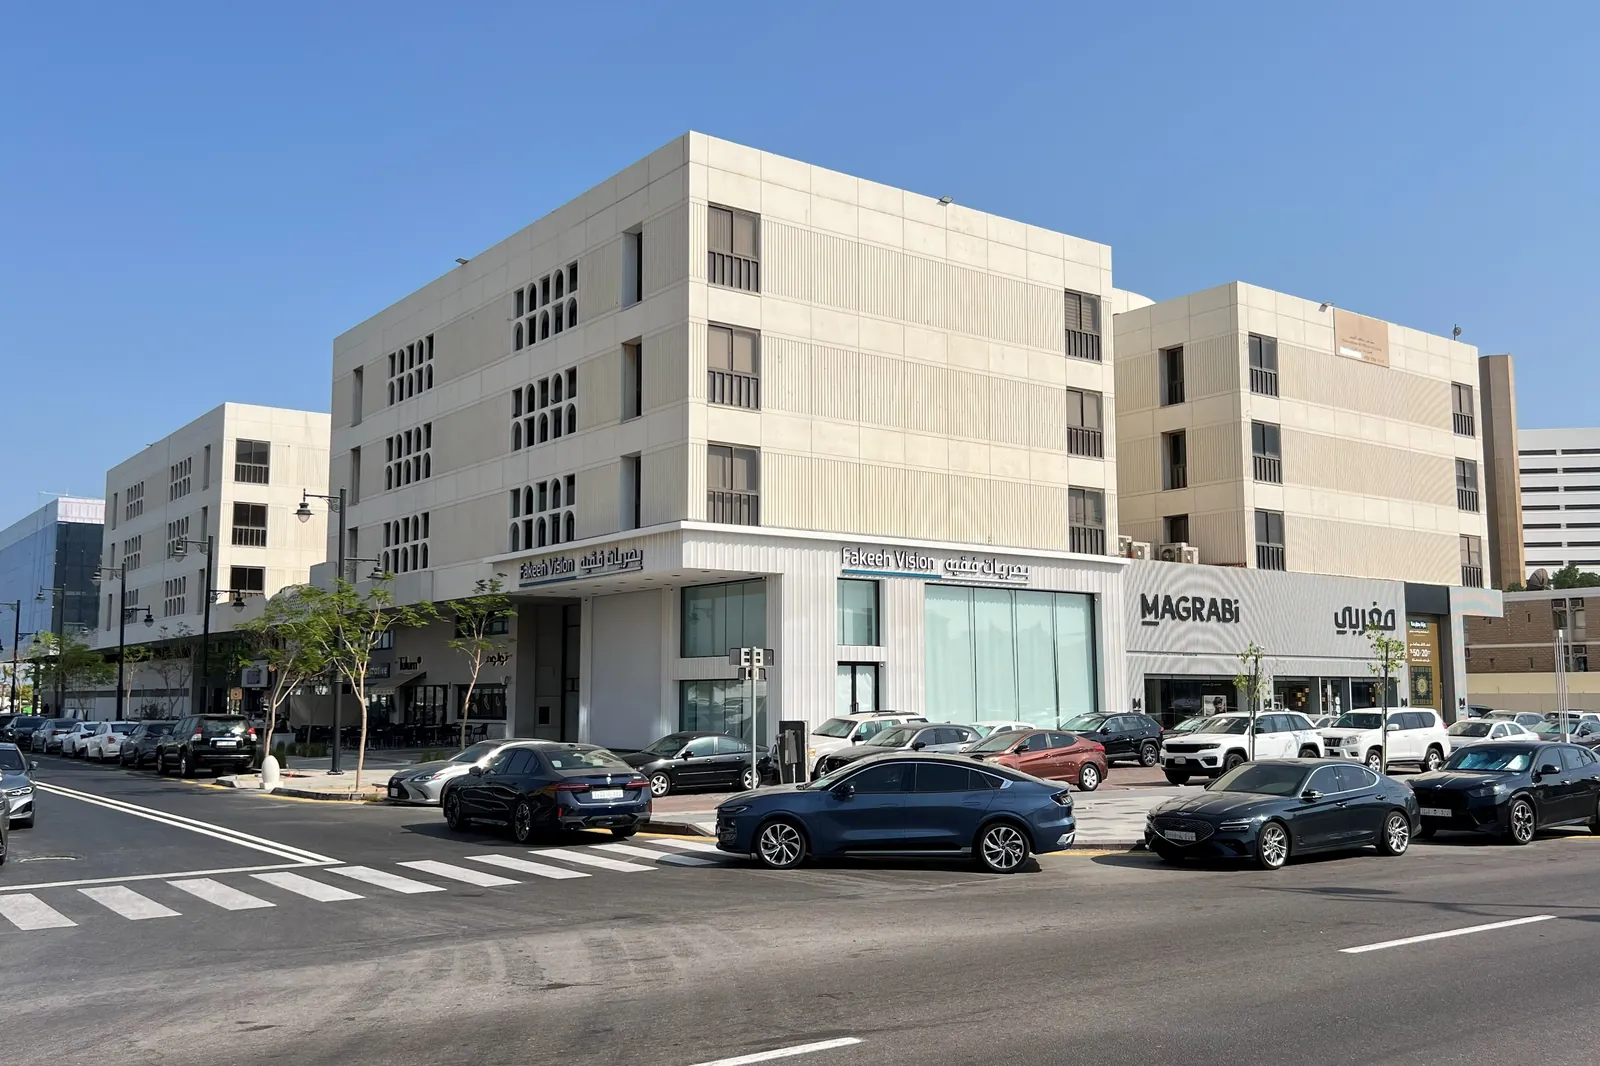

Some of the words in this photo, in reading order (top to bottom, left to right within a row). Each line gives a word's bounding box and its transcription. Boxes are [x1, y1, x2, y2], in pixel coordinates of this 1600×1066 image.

[520, 560, 548, 579] Fakeeh
[550, 557, 575, 575] Vision
[580, 551, 604, 573] فقيه
[607, 547, 643, 570] بصريات
[842, 547, 891, 567] Fakeeh
[894, 550, 935, 569] Vision
[944, 556, 979, 576] فقيه
[982, 558, 1030, 580] بصريات
[1334, 601, 1396, 636] مغربي
